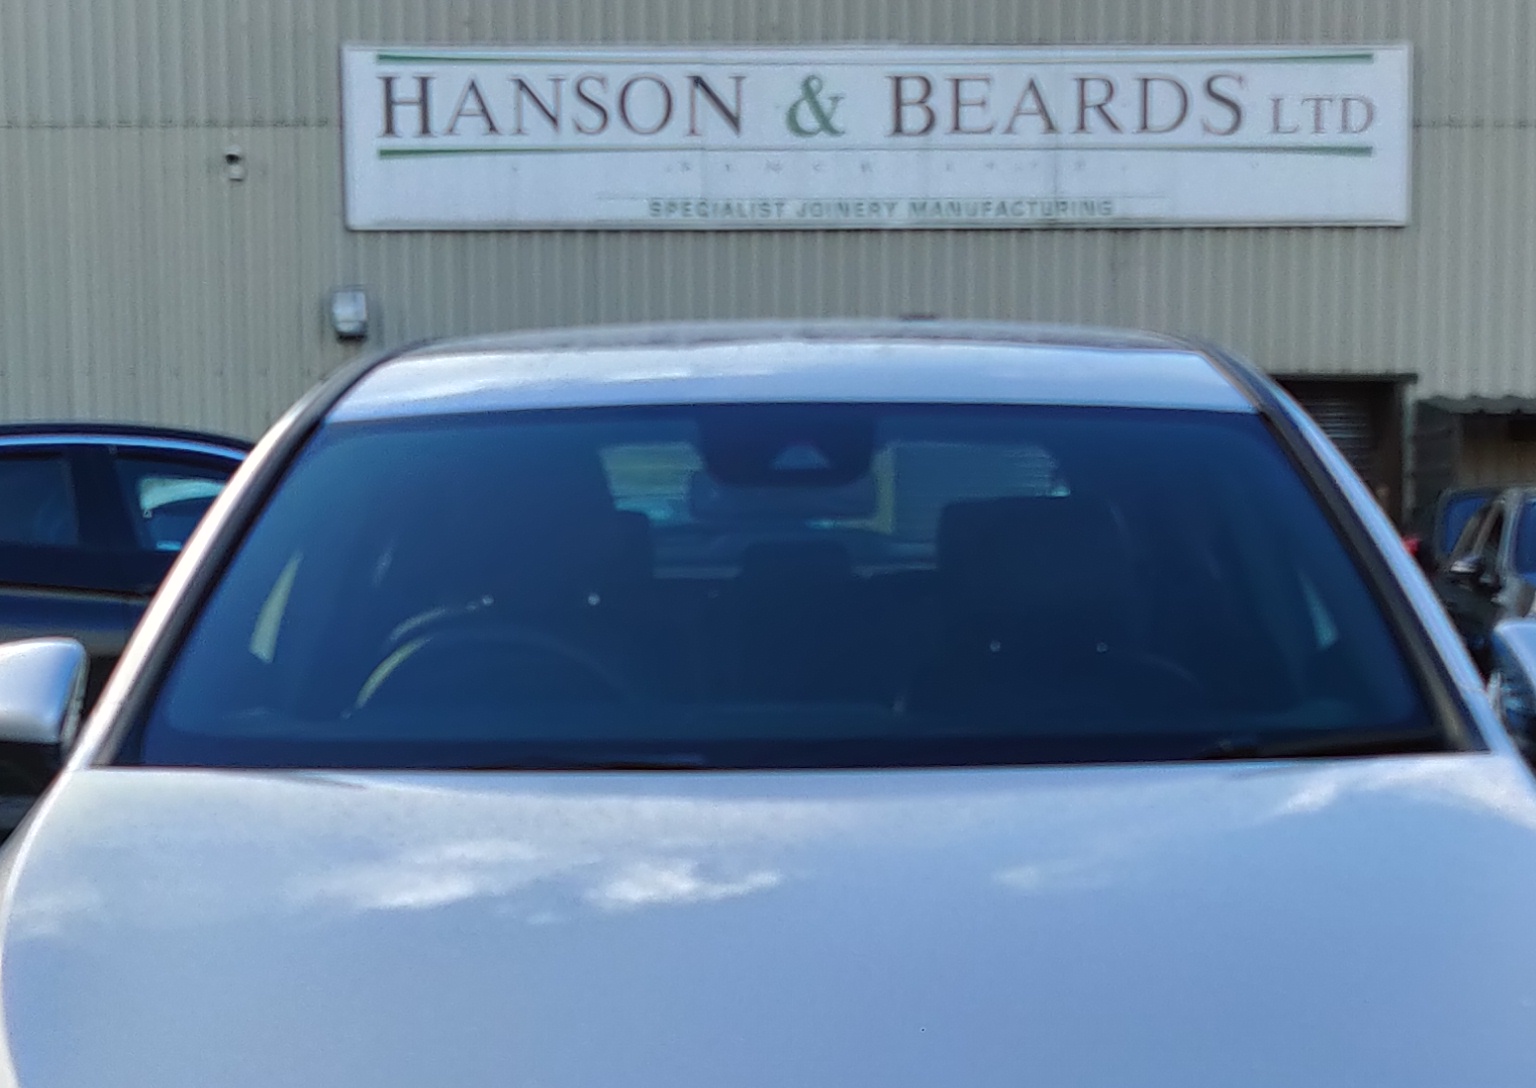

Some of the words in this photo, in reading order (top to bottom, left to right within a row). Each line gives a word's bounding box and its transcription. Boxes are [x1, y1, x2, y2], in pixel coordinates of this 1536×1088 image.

[376, 74, 749, 139] HANSON
[784, 73, 847, 138] &
[883, 73, 1249, 138] BEARDS
[1269, 95, 1375, 136] LTD
[648, 199, 785, 219] SPECIALIST
[795, 199, 896, 219] JOINERY
[907, 199, 1114, 219] MANUFACTURING
